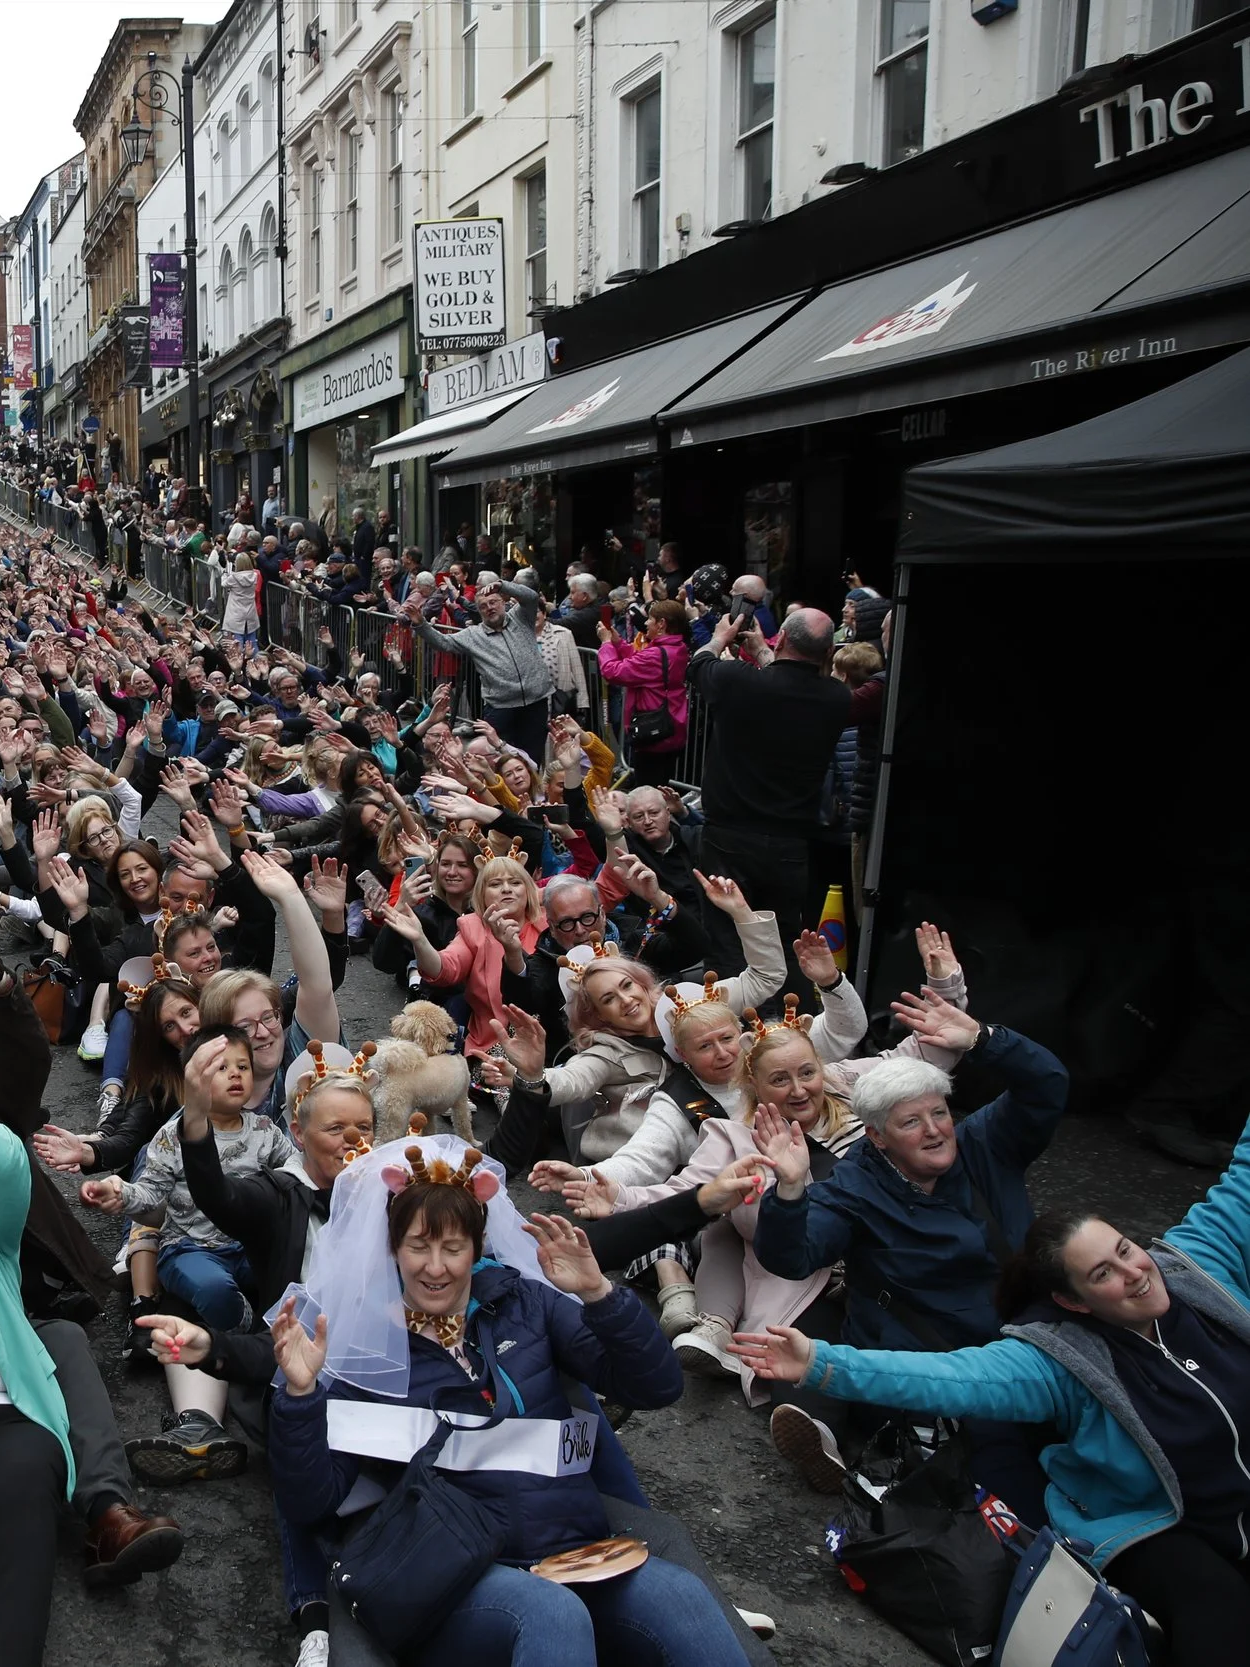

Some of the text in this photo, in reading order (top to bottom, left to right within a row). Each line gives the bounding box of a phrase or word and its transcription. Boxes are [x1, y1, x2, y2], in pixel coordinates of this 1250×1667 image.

[1079, 81, 1215, 168] The
[419, 225, 500, 243] ANTIQUES,
[425, 242, 494, 260] MILITARY
[424, 268, 496, 288] WE BUY
[426, 289, 495, 309] GOLD &
[428, 310, 493, 329] SILVER
[420, 334, 506, 352] TEL: 07756008223
[1030, 337, 1178, 379] The River Inn
[322, 351, 394, 407] Barnardo's
[444, 345, 527, 406] BEDLAM
